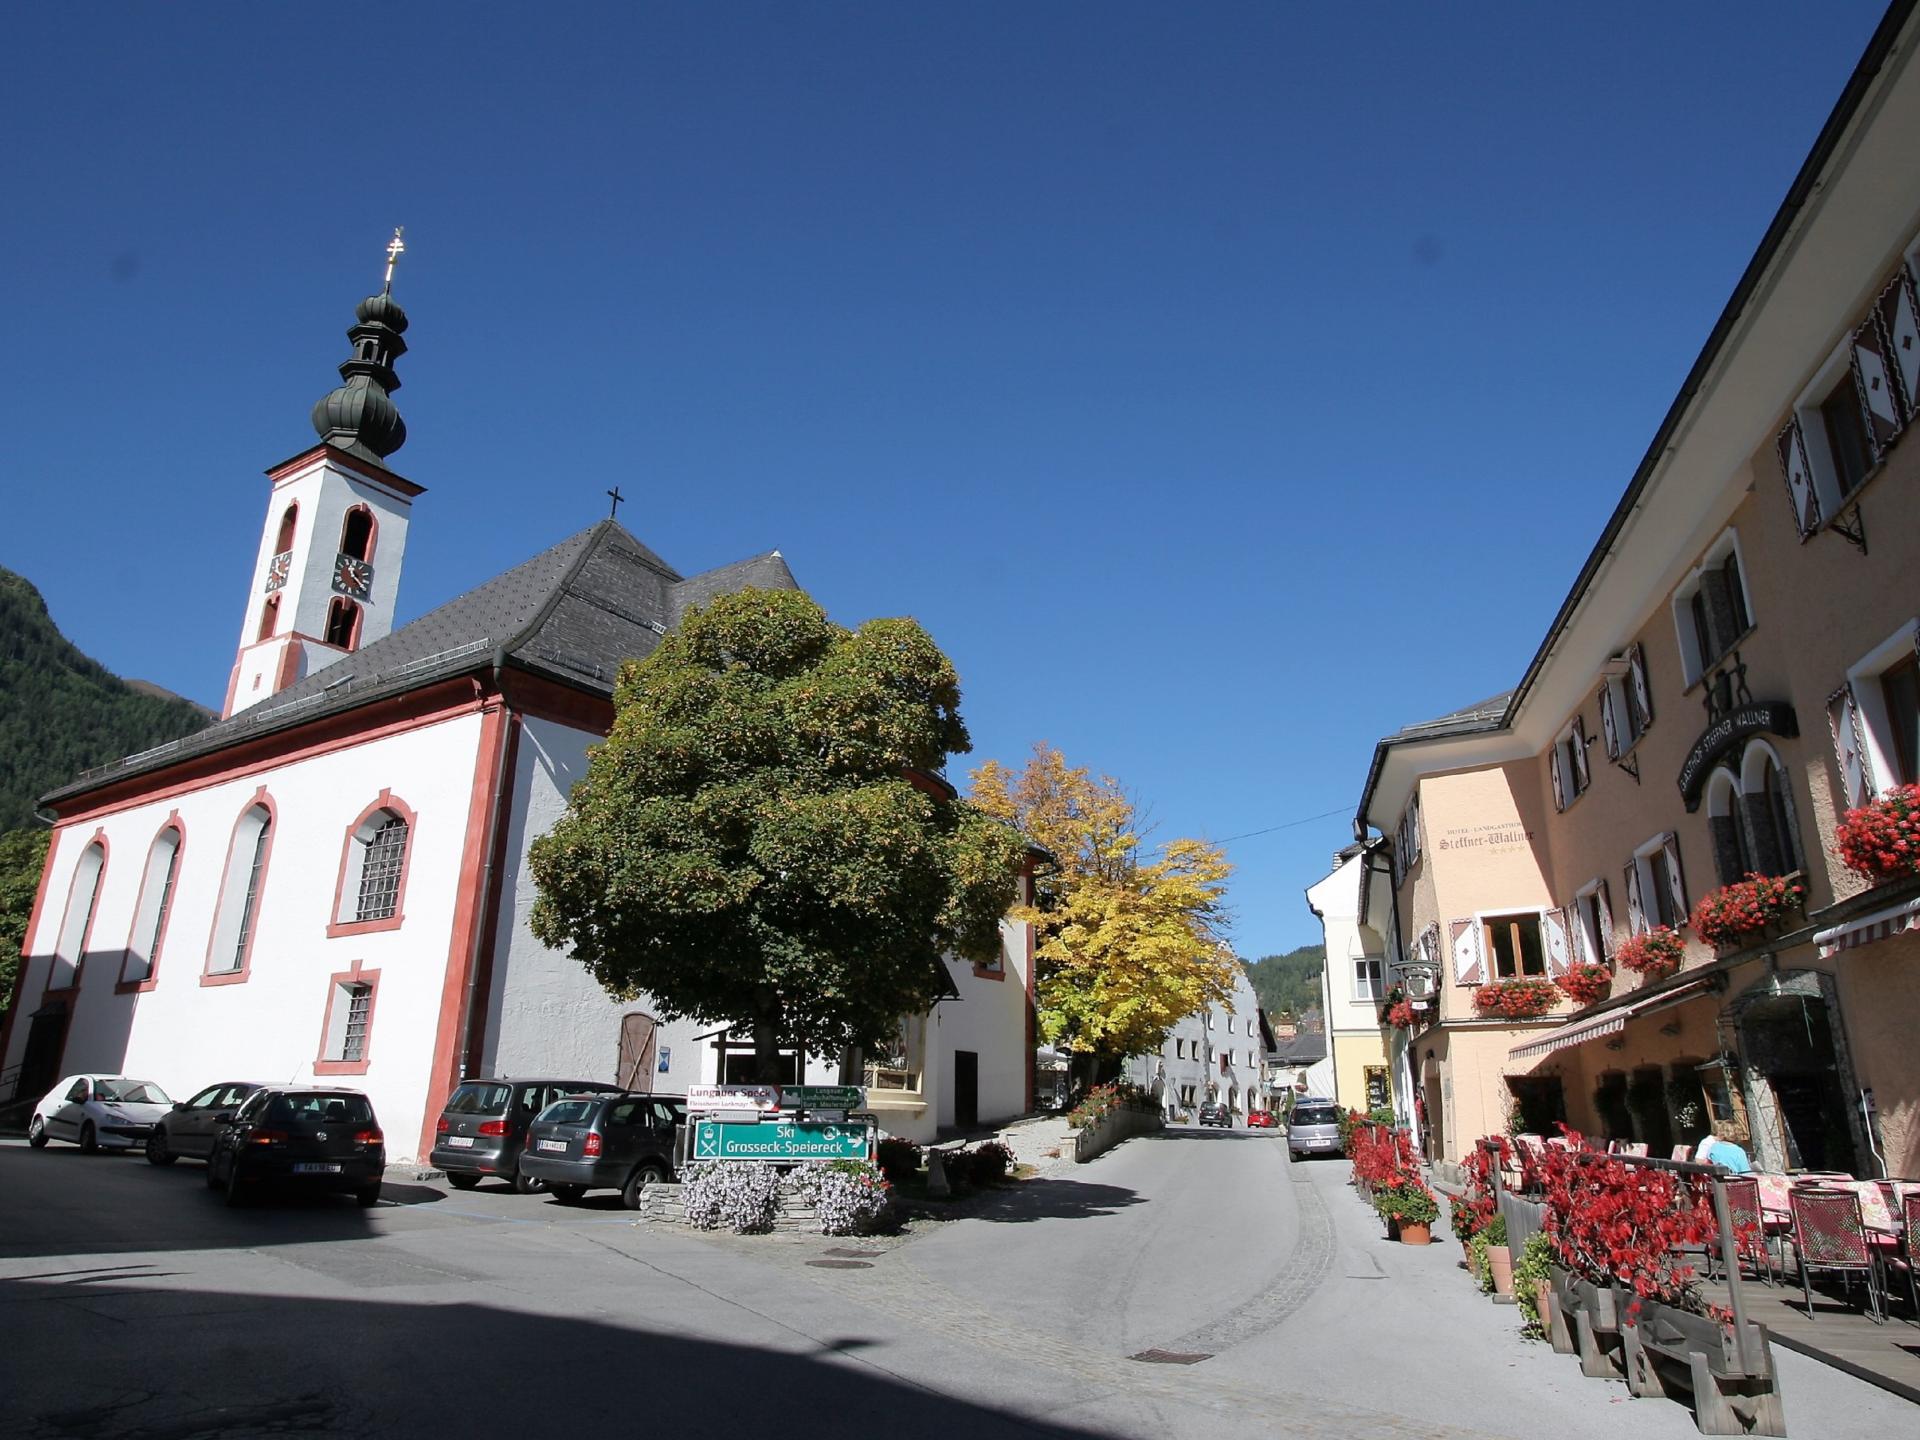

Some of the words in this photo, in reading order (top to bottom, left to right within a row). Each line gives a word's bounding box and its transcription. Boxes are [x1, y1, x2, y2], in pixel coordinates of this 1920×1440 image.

[1679, 746, 1703, 792] GASTHOF
[1703, 719, 1733, 753] STEFFNER
[1736, 709, 1771, 726] WALLNER
[690, 1087, 738, 1099] Lungauer
[740, 1087, 770, 1098] Speck
[776, 1125, 795, 1139] Ski
[726, 1140, 843, 1155] Grosseck-Speiereck
